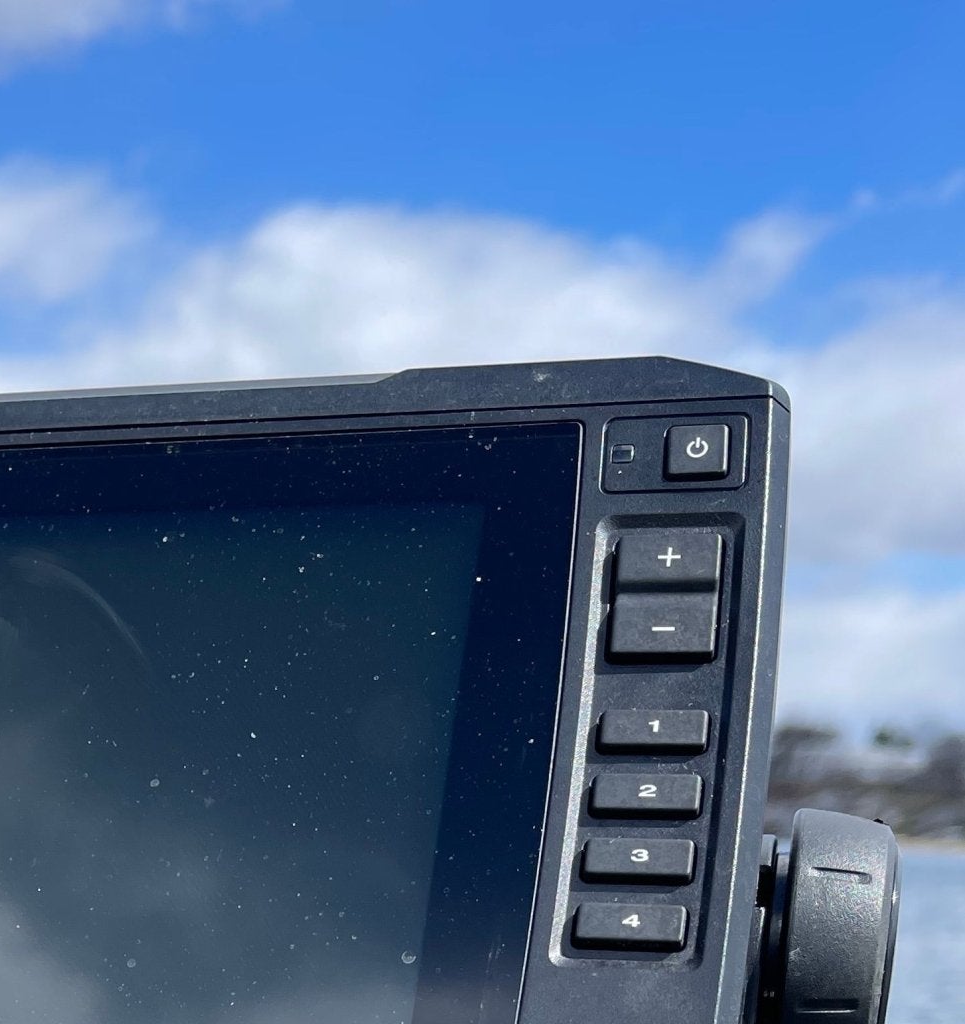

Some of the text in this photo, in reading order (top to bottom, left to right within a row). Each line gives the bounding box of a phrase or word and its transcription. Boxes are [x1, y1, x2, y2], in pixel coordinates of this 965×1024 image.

[648, 719, 660, 733] 1
[637, 783, 658, 798] 2
[630, 848, 650, 863] 3
[621, 913, 641, 928] 4
